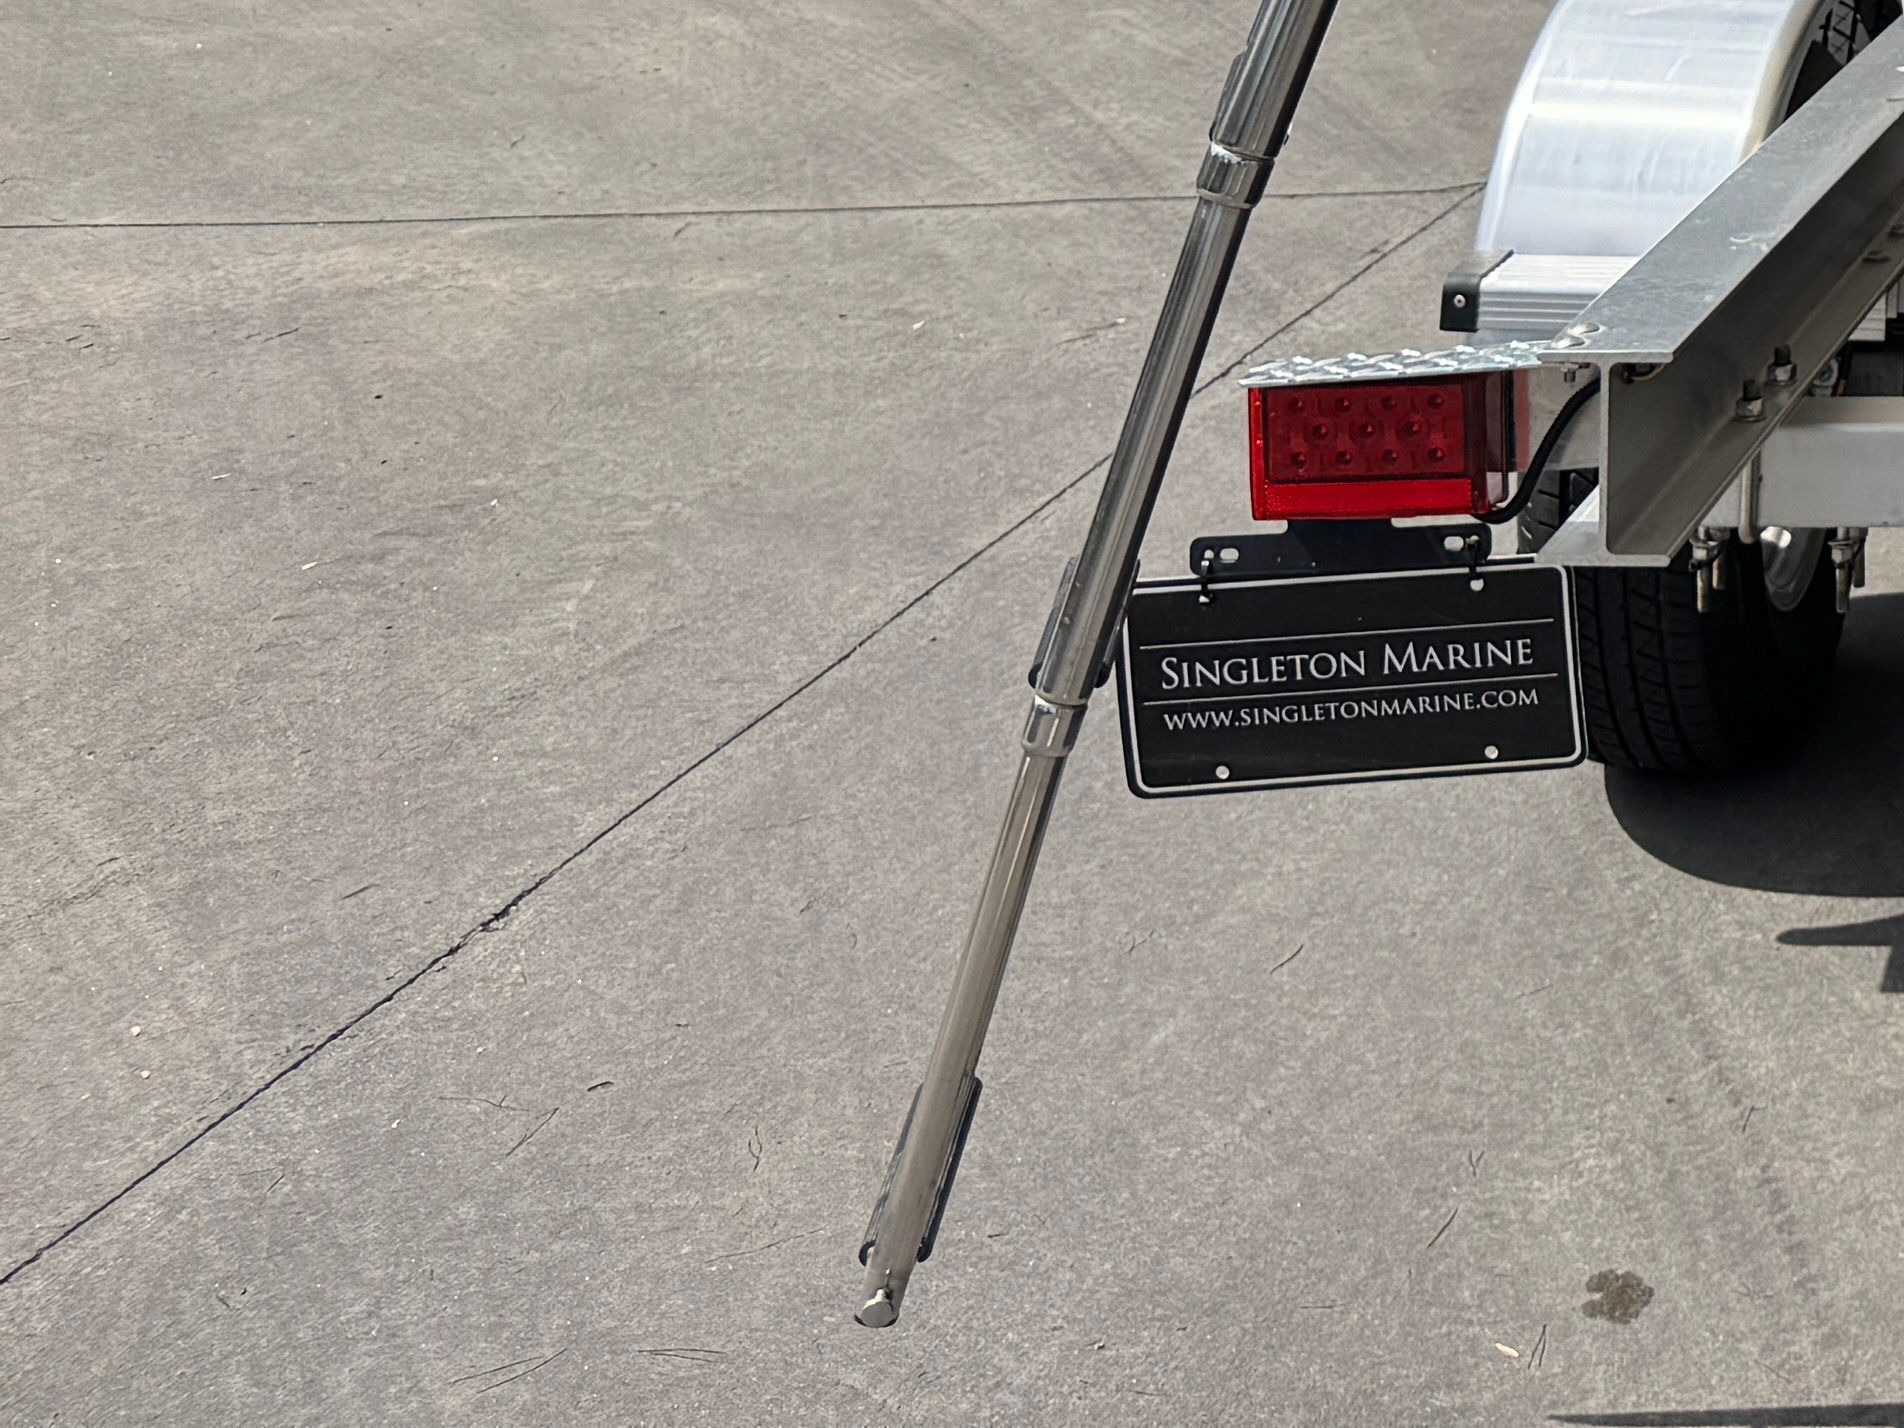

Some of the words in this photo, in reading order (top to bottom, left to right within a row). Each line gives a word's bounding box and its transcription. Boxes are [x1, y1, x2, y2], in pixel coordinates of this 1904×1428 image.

[1161, 649, 1367, 690] SINGLETON
[1383, 638, 1535, 676] MARINE
[1163, 688, 1540, 732] WWW.SINGLETONMARINE.COM
